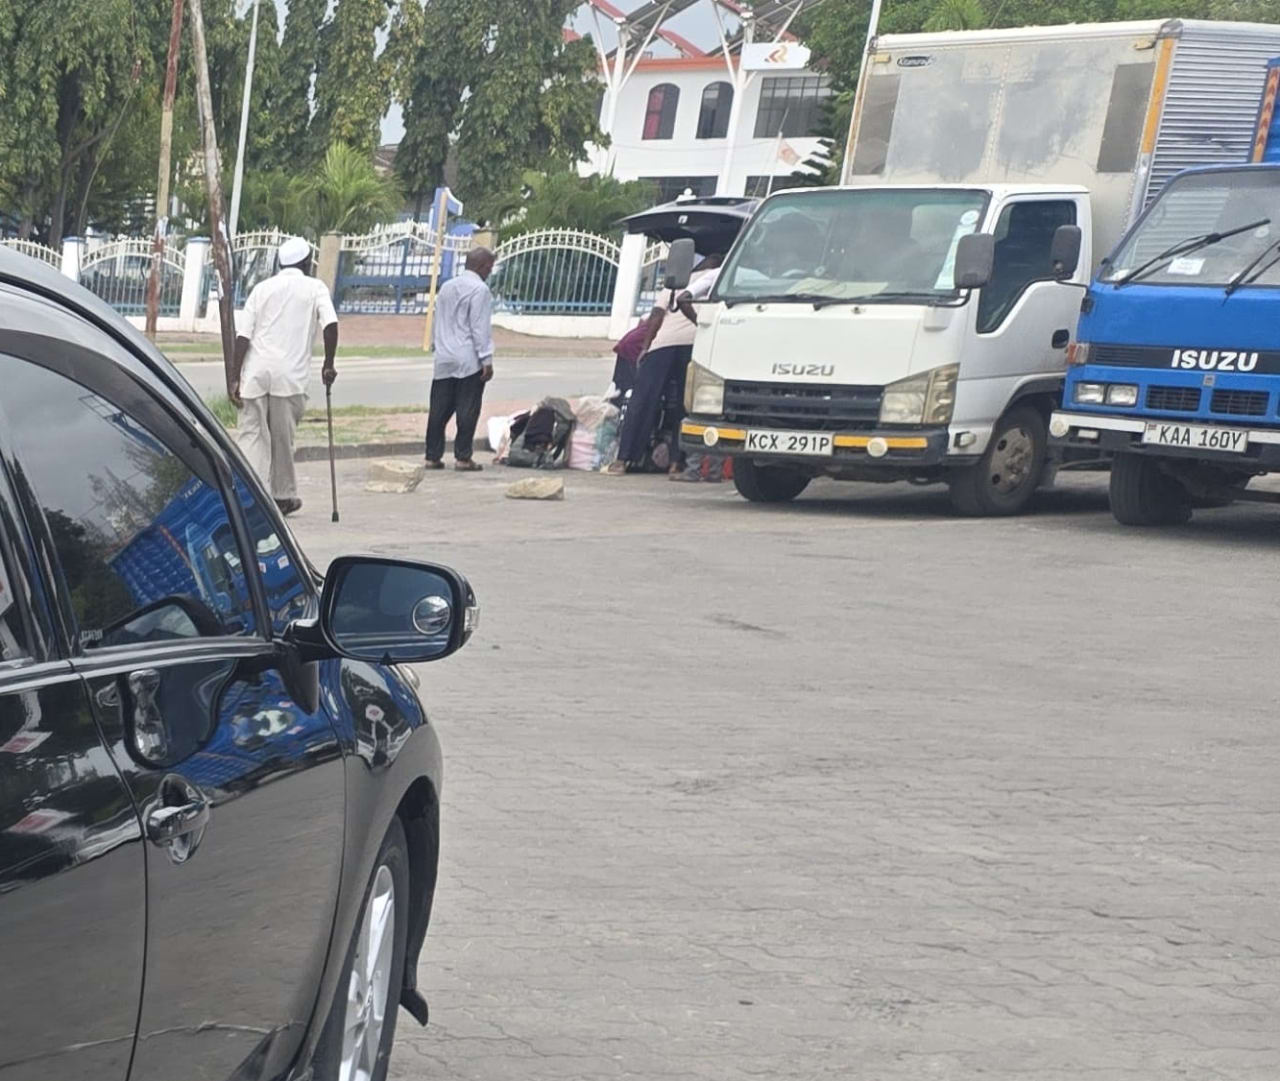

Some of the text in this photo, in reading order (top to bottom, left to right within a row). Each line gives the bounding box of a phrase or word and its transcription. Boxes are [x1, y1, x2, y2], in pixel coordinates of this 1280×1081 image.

[771, 362, 835, 377] ISUZU
[1171, 349, 1259, 372] ISUZU
[748, 433, 830, 452] KCX 291P
[1159, 425, 1243, 450] KAA 160Y
